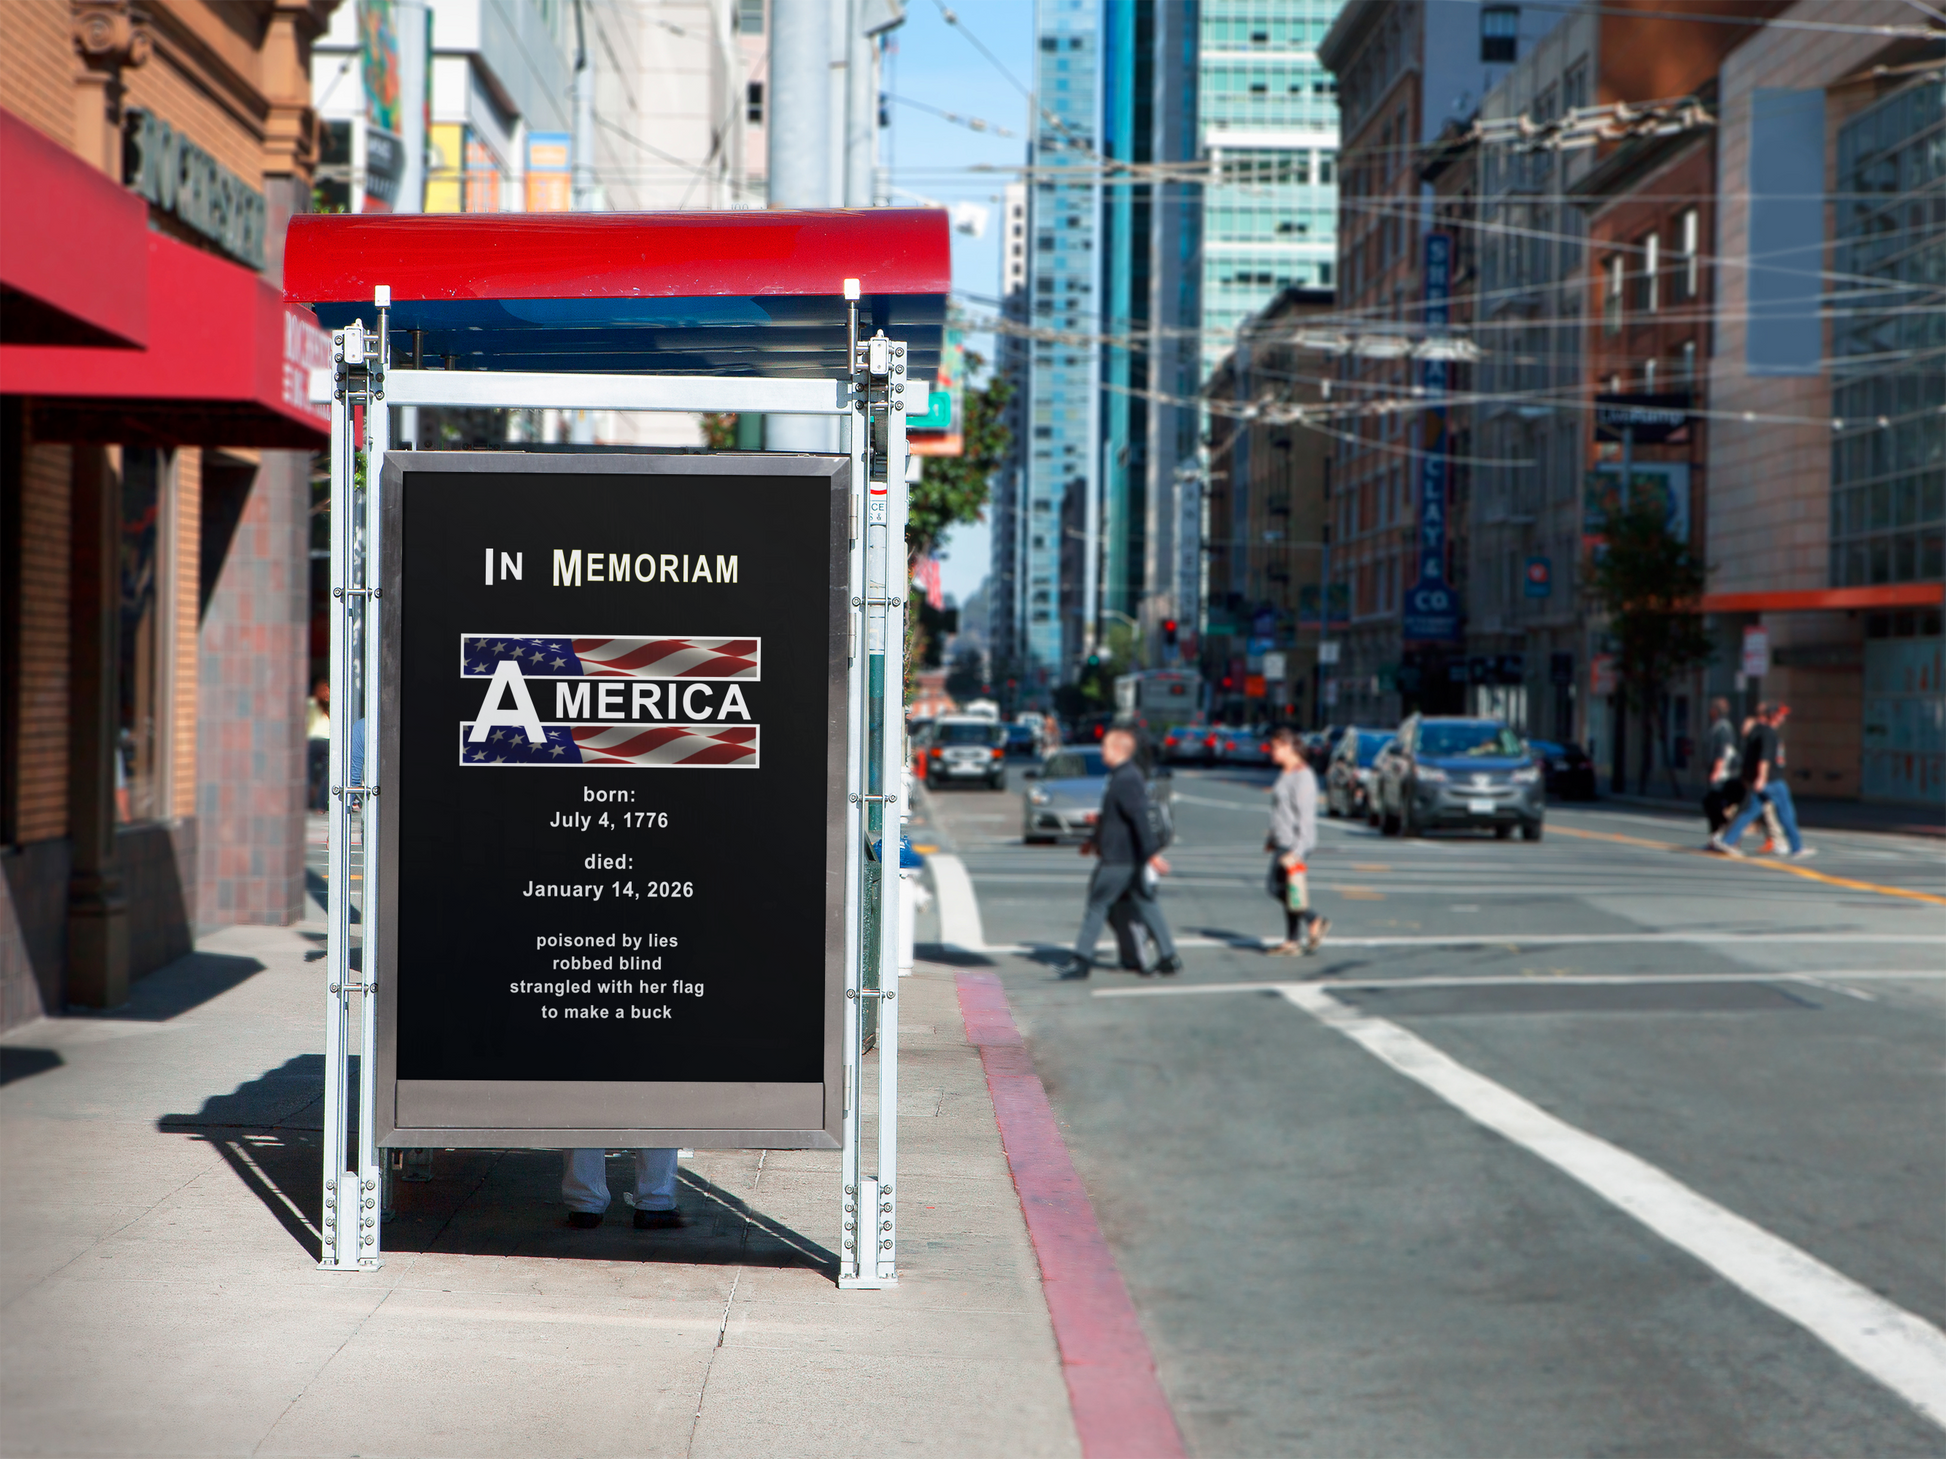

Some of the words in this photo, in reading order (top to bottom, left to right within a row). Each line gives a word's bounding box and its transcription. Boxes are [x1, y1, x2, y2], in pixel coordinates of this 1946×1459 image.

[583, 785, 635, 803] born:
[550, 811, 592, 832] July
[598, 811, 615, 831] 4,
[623, 811, 669, 829] 1776
[584, 853, 633, 870] died:
[522, 880, 604, 902] January
[611, 881, 640, 900] 14,
[647, 881, 694, 898] 2026
[536, 932, 616, 950] poisoned
[622, 933, 643, 951] by
[648, 933, 679, 948] lies
[552, 955, 613, 971] robbed
[619, 955, 662, 971] blind
[509, 979, 591, 997] strangled
[597, 979, 633, 995] with
[639, 979, 668, 995] her
[672, 979, 704, 998] flag
[541, 1004, 558, 1020] to
[564, 1004, 609, 1020] make
[615, 1007, 625, 1020] a
[631, 1004, 672, 1020] buck
